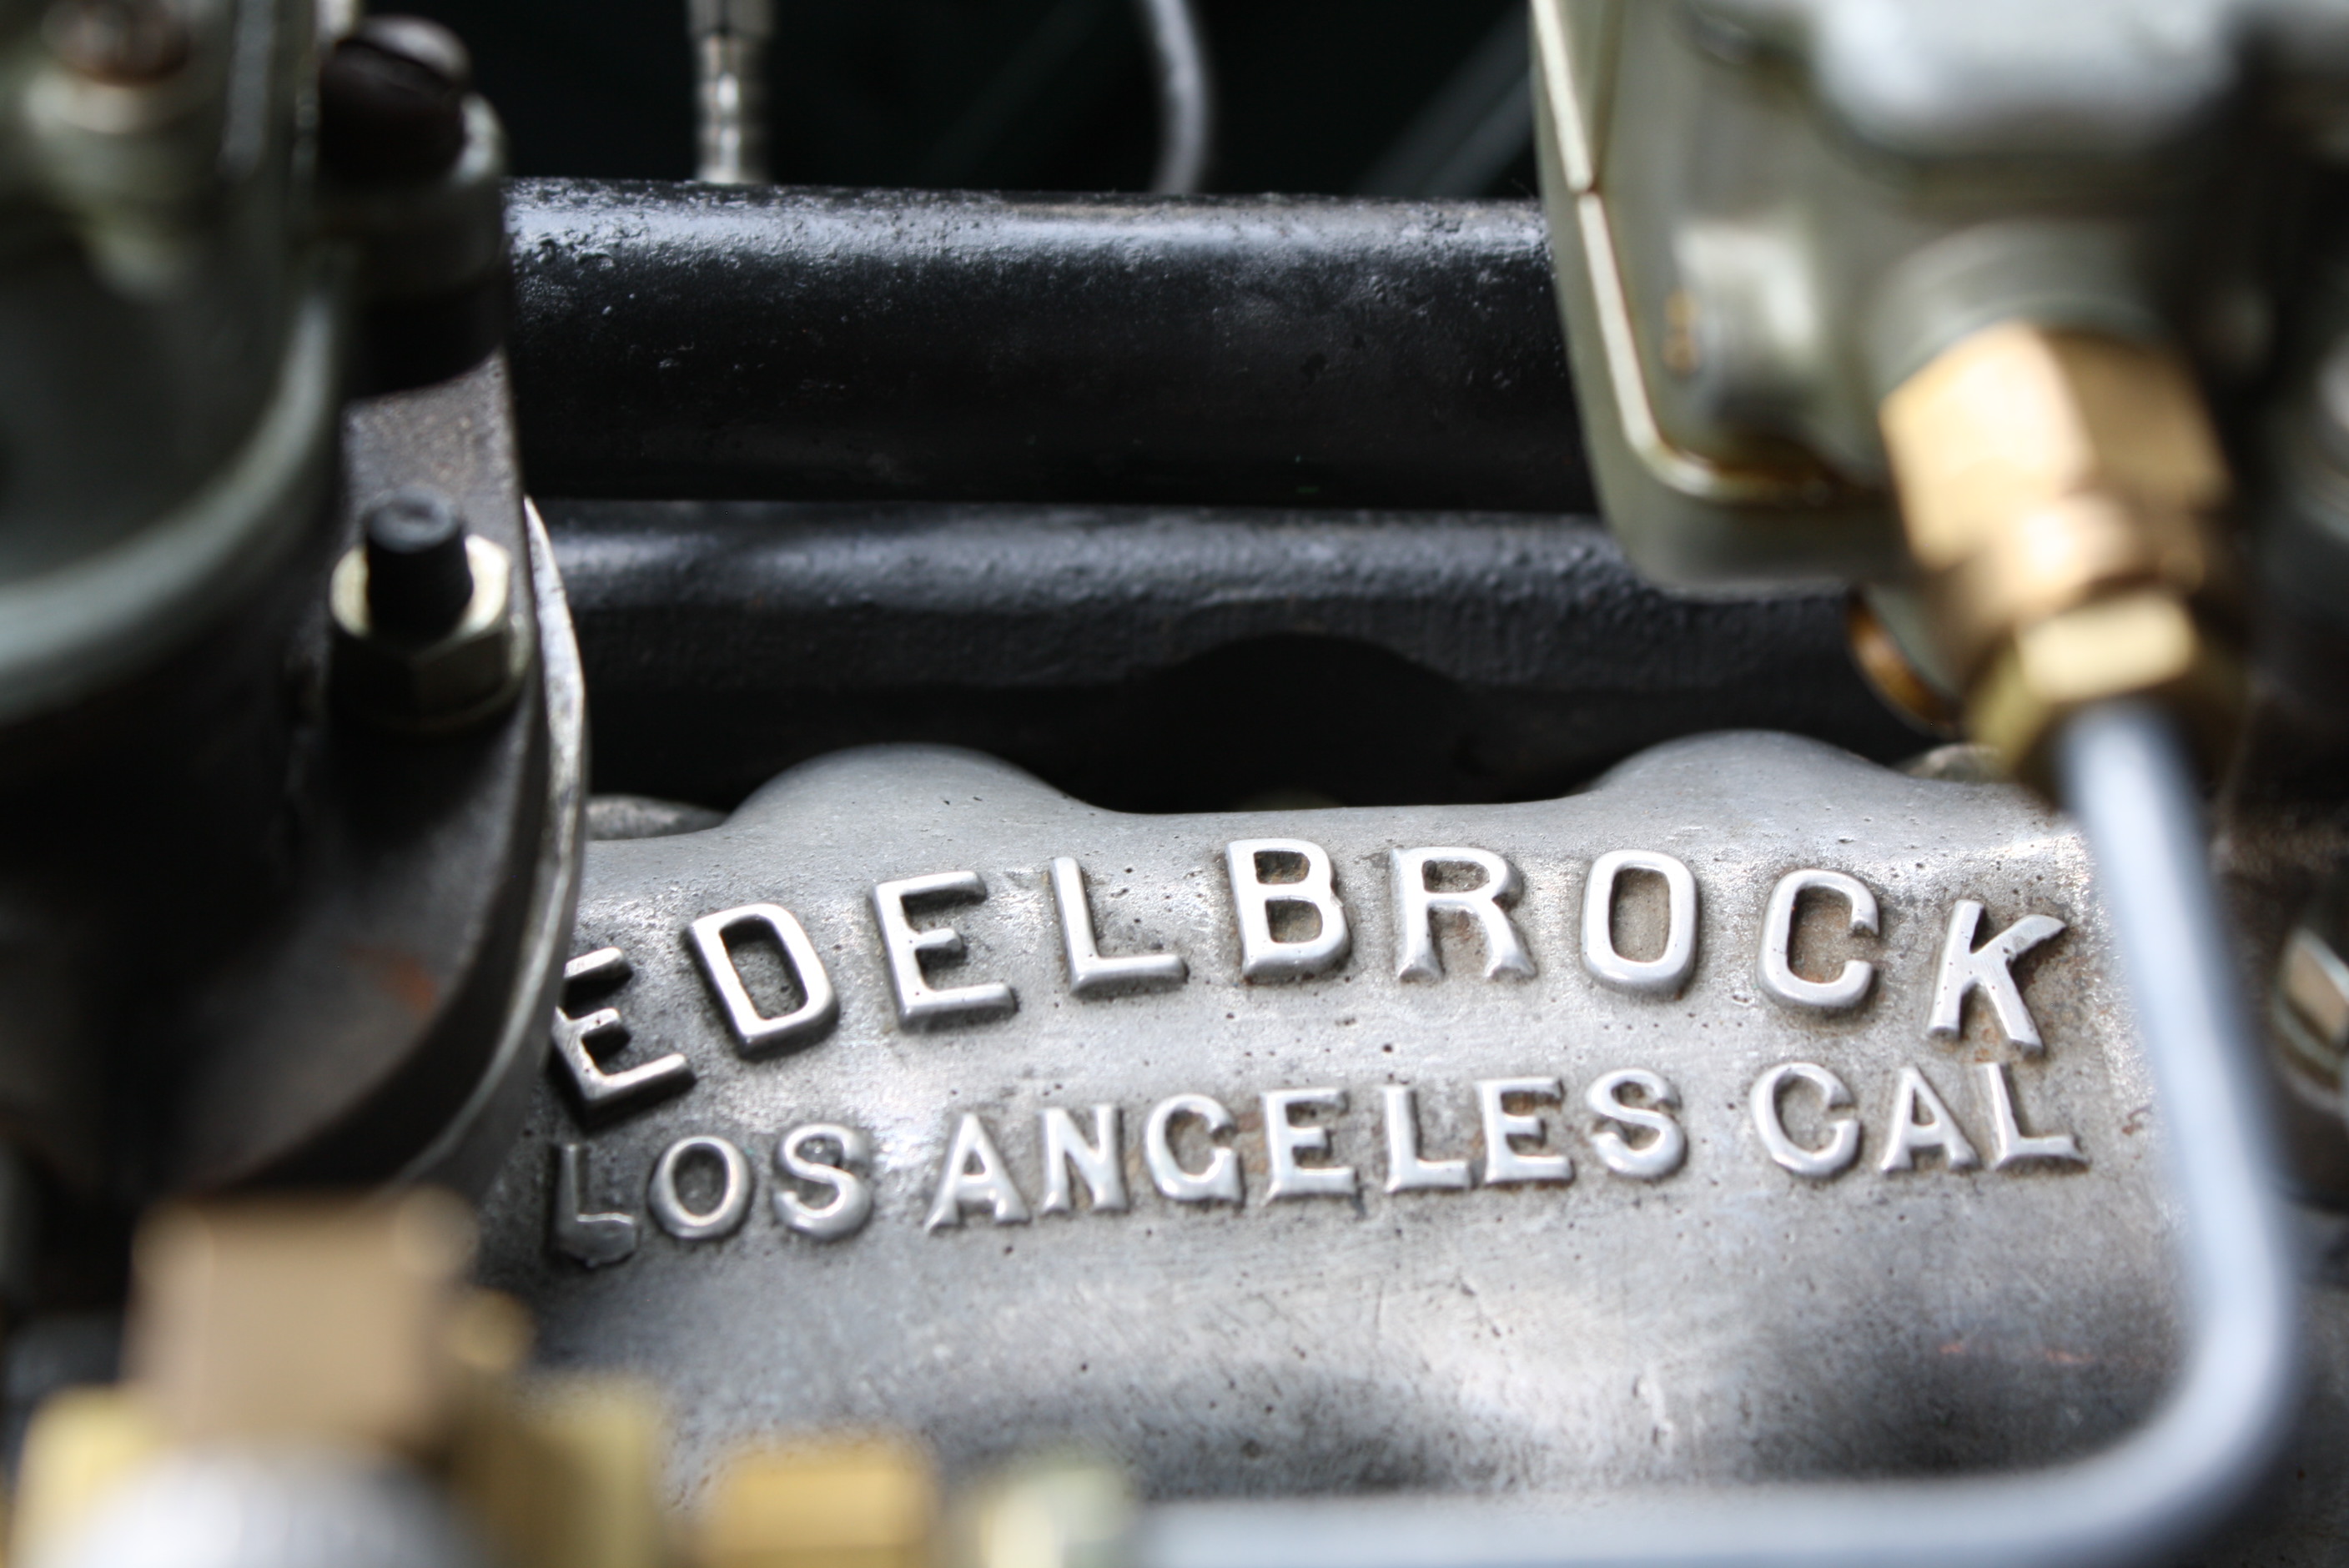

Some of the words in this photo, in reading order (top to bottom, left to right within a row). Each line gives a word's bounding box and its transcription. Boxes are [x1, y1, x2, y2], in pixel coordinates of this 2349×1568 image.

[551, 837, 2067, 1113] EDELBROCK
[554, 1123, 873, 1264] LOS
[923, 1067, 1688, 1234] ANGELES
[1750, 1061, 2089, 1178] CAL
